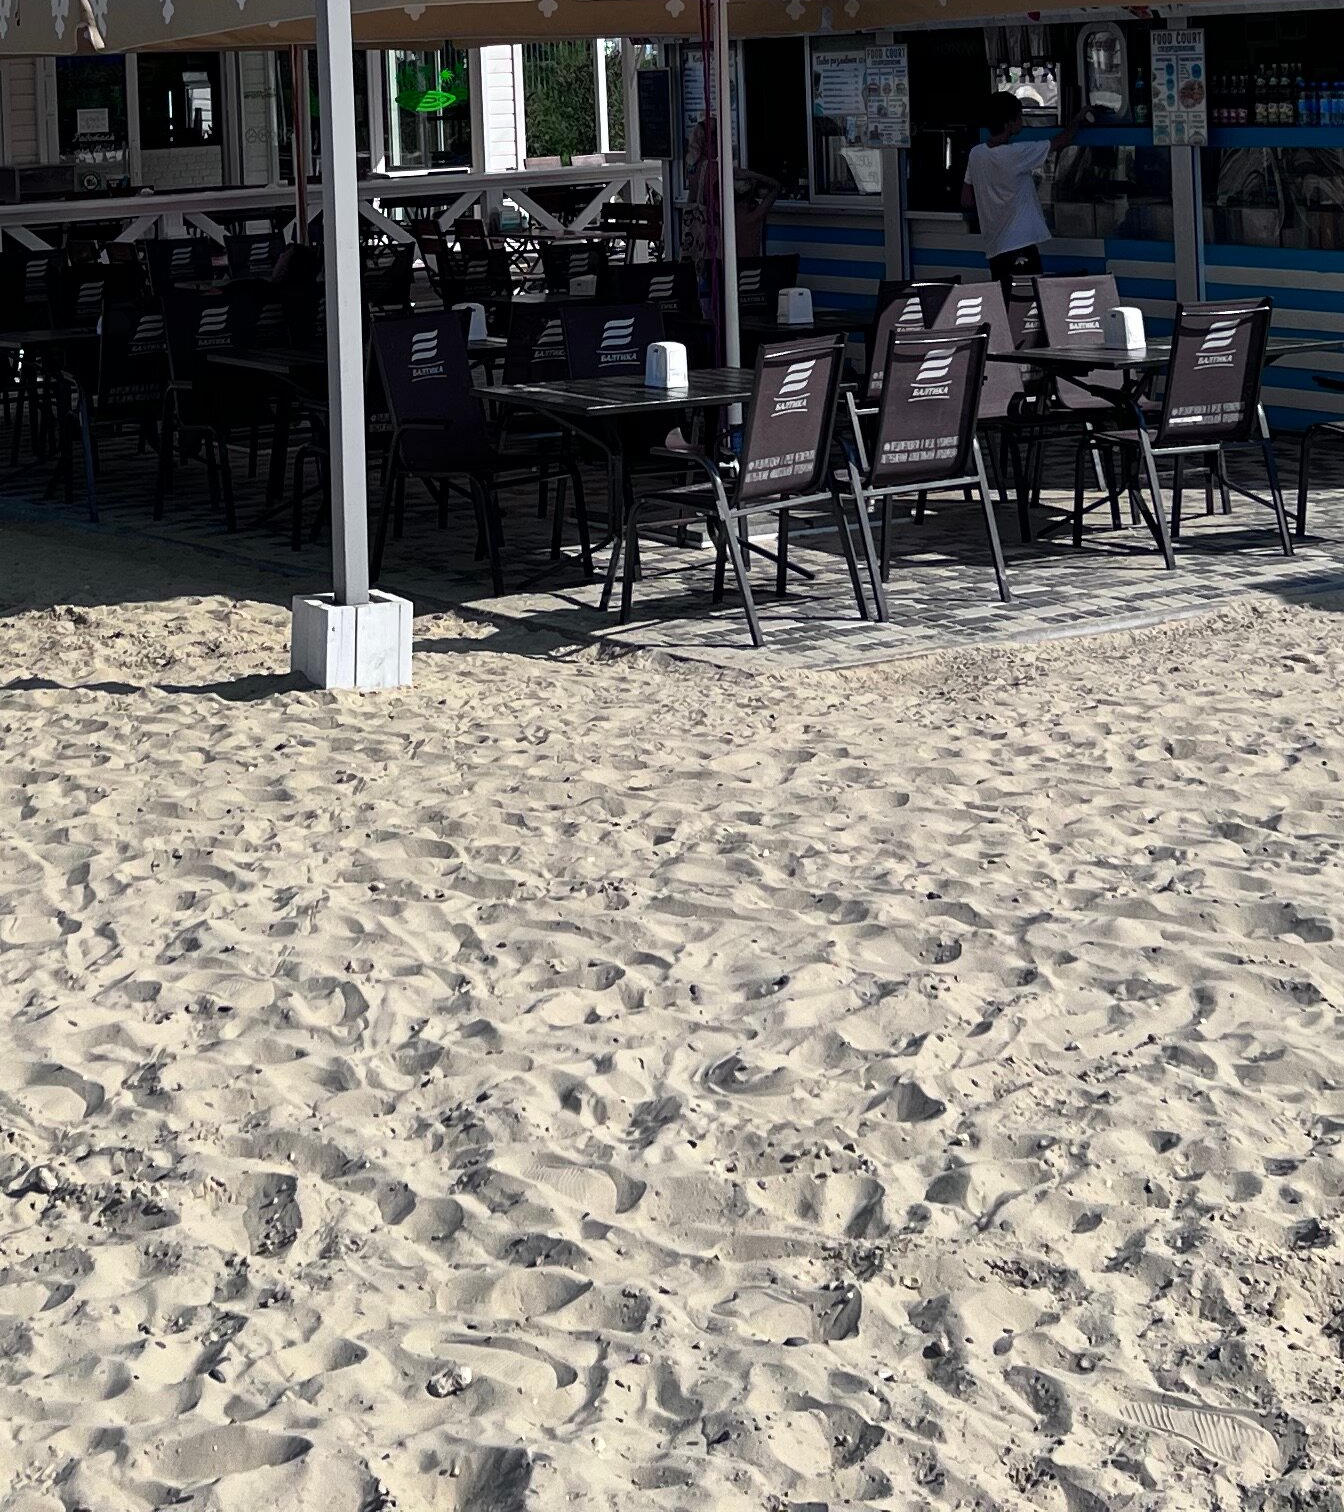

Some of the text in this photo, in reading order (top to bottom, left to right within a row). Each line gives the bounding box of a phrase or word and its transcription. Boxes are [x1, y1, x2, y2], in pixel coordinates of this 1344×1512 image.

[1152, 31, 1201, 45] FOOD COURT
[867, 48, 905, 59] FOOD COURT
[1069, 321, 1100, 330] БАЛТИКА
[601, 352, 638, 363] БАЛТИКА
[1197, 354, 1233, 365] БАЛТИКА
[412, 364, 444, 377] БАЛТИКА
[912, 386, 950, 397] БАЛТИКА
[775, 398, 808, 411] БАЛТИКА
